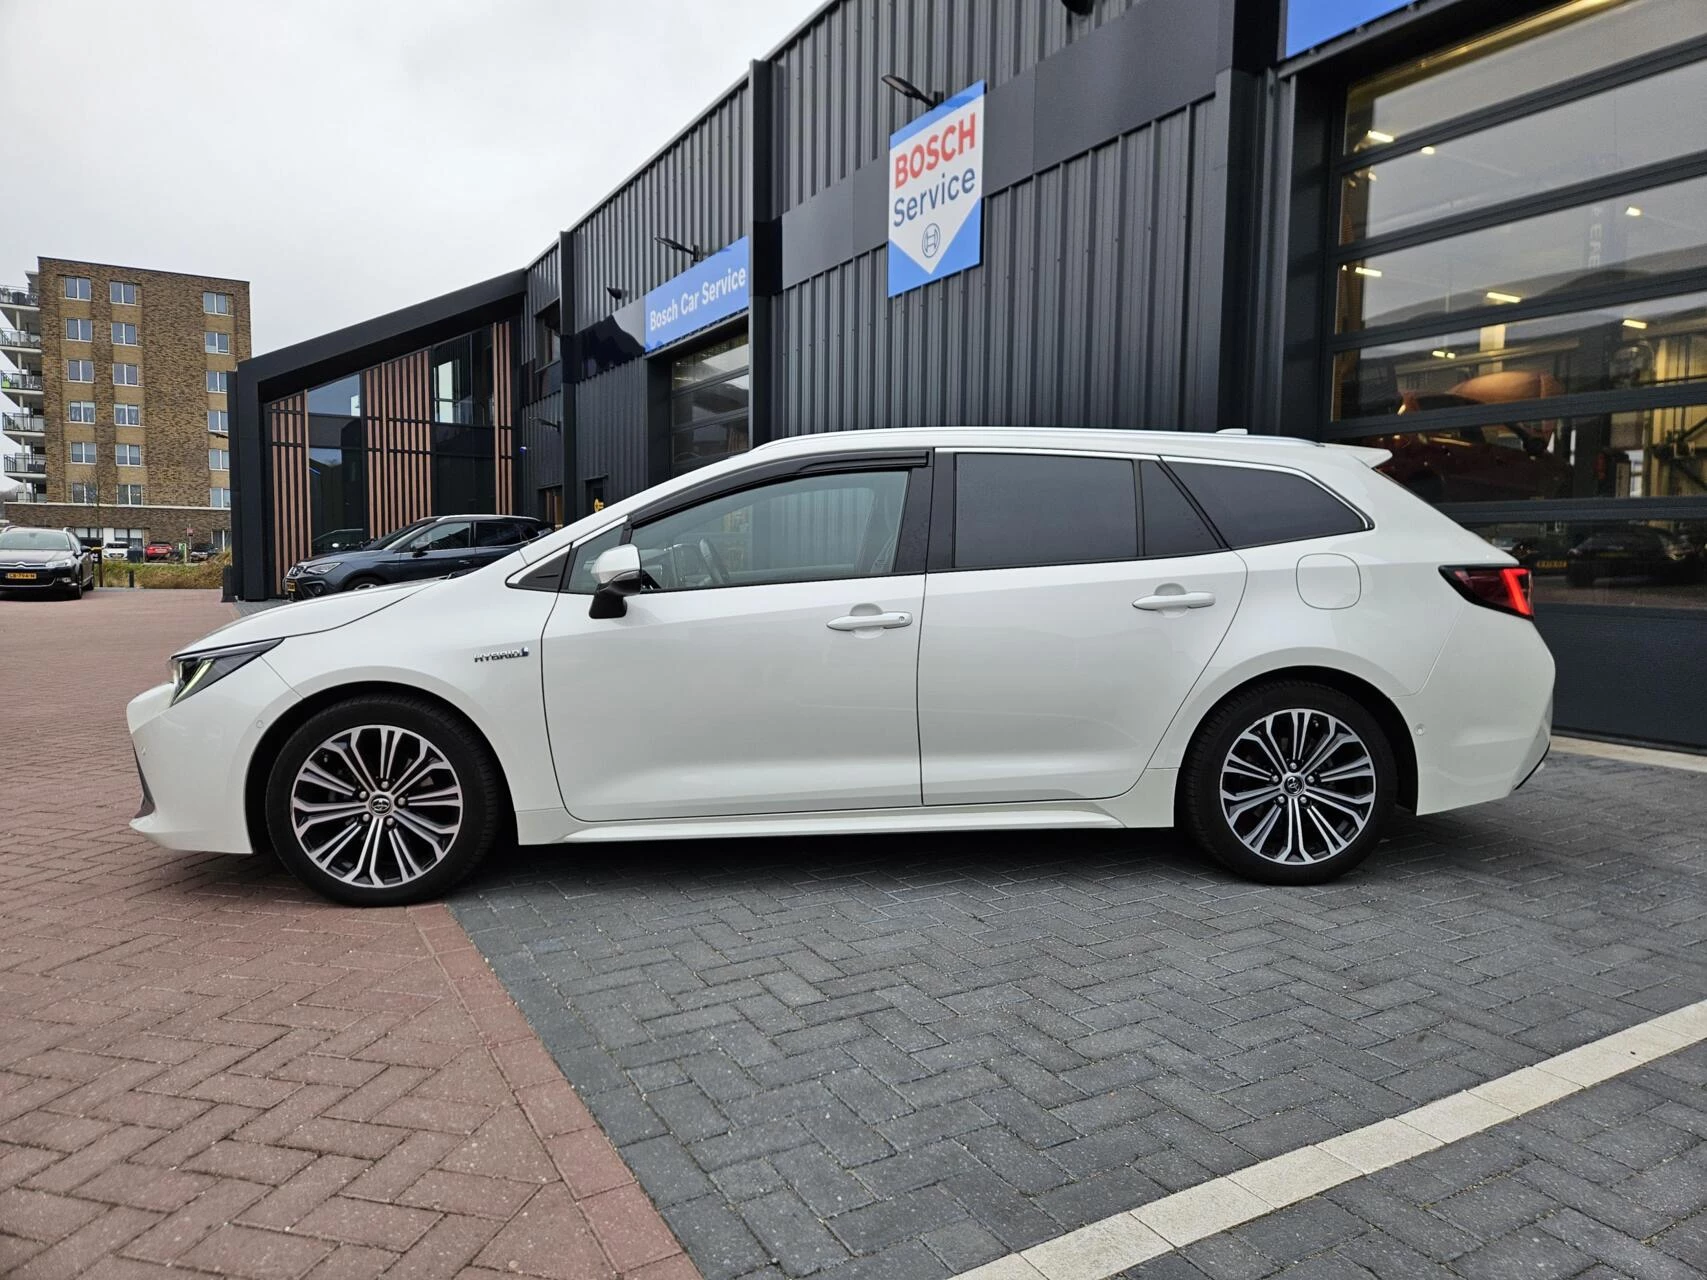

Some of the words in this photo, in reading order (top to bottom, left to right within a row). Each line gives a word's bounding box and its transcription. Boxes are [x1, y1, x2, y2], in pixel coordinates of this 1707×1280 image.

[895, 112, 976, 189] BOSCH
[893, 168, 975, 227] Service
[650, 299, 679, 331] Bosch
[681, 293, 700, 315] Car
[702, 267, 746, 305] Service
[474, 649, 521, 662] HYBRID
